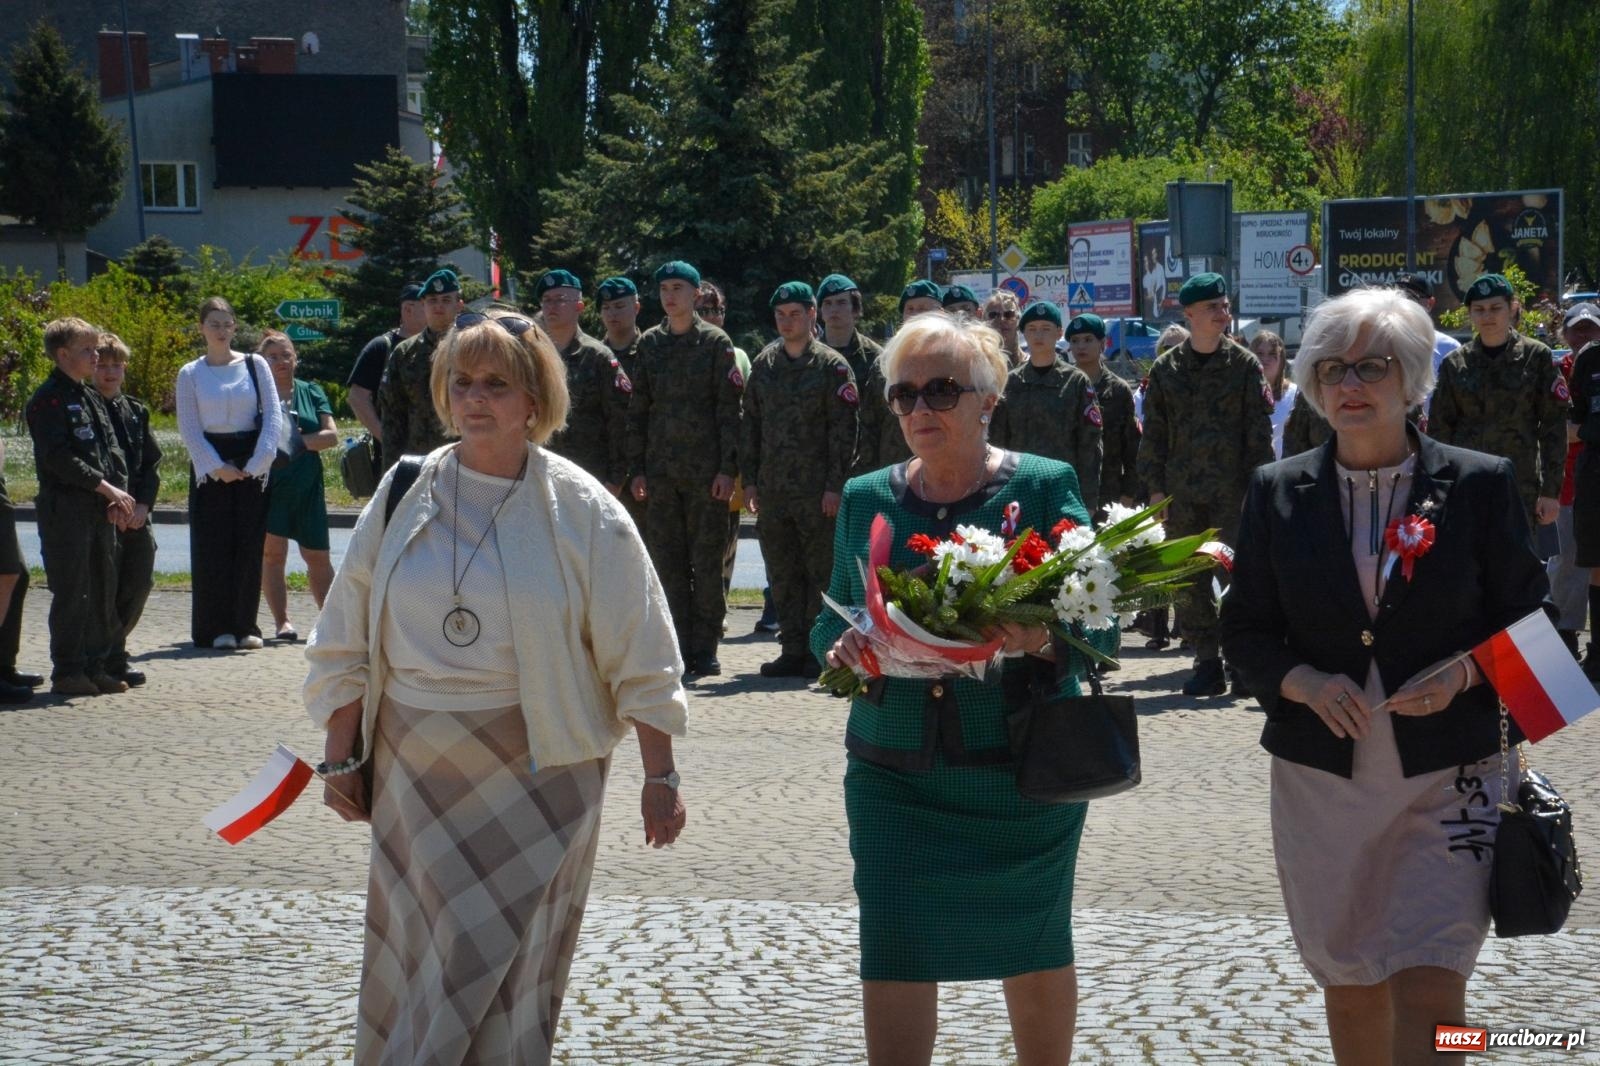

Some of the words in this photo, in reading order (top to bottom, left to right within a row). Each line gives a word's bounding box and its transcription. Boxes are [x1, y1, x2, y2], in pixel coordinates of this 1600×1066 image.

[1339, 228, 1362, 241] Twój
[1364, 227, 1399, 239] lokalny
[1511, 226, 1549, 239] JANETA
[1338, 251, 1437, 268] PRODUCNT
[1338, 268, 1443, 287] GARMAŻRKI
[290, 304, 333, 319] Rybnik
